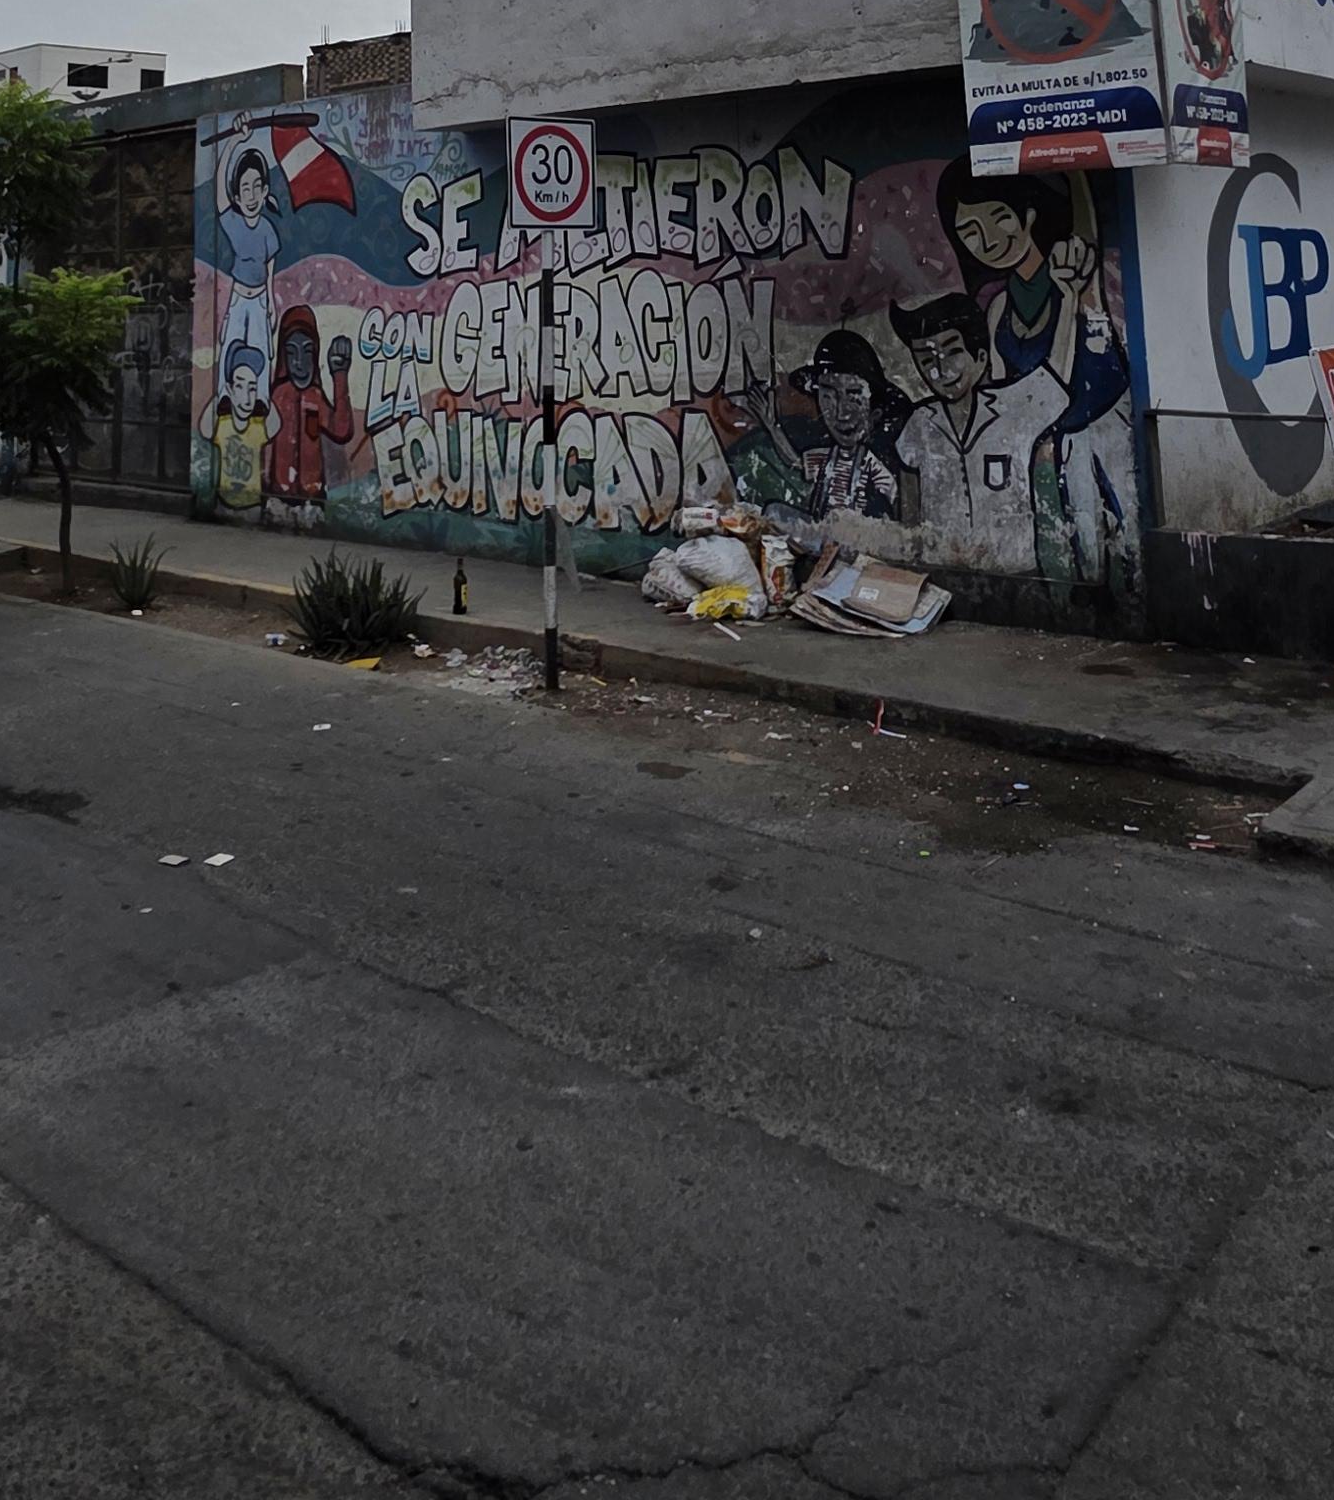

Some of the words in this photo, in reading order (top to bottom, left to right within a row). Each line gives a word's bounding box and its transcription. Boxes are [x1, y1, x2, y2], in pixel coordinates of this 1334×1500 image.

[972, 83, 1004, 98] EVITA
[1005, 82, 1019, 94] LA
[1022, 78, 1063, 92] MULTA
[1064, 75, 1079, 87] DE
[1023, 97, 1096, 114] Ordenanza
[1017, 108, 1128, 133] 458-2023-MDI
[531, 143, 574, 186] 30
[401, 169, 484, 277] SE
[358, 305, 436, 364] CON
[440, 258, 776, 407] GENERACIÓN
[364, 356, 422, 431] LA
[369, 406, 741, 536] EQUIVOCADA
